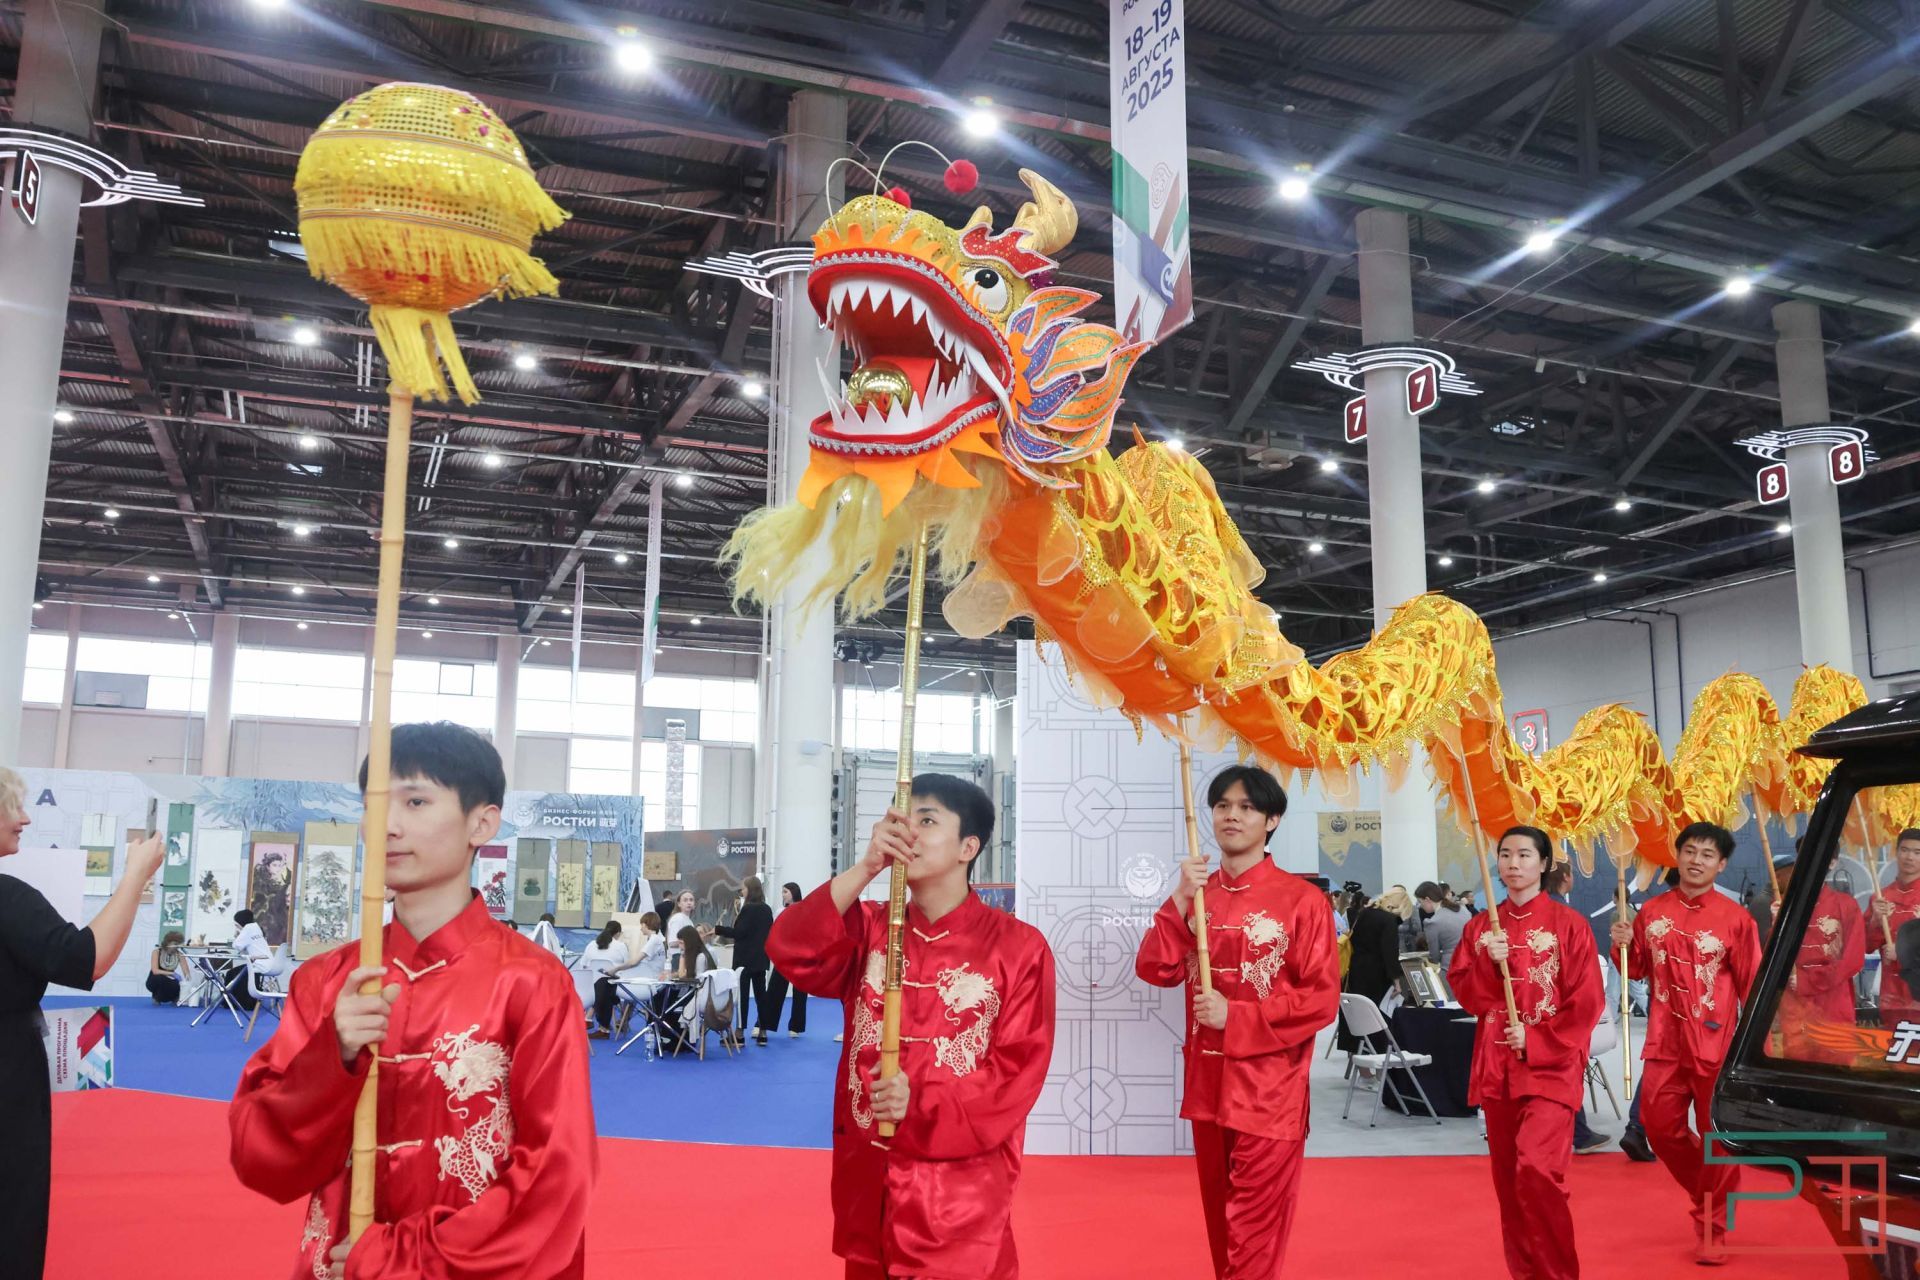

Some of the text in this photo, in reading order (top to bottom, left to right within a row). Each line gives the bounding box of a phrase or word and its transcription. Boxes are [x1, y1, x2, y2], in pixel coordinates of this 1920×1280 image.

[1121, 26, 1180, 96] АВГУСТА
[1127, 57, 1174, 122] 2025
[26, 169, 37, 205] 5
[1414, 374, 1427, 403] 7
[1352, 405, 1364, 431] 7
[1839, 451, 1853, 474] 8
[1766, 473, 1780, 495] 8
[1522, 721, 1537, 752] 3
[543, 816, 597, 827] РОСТКИ
